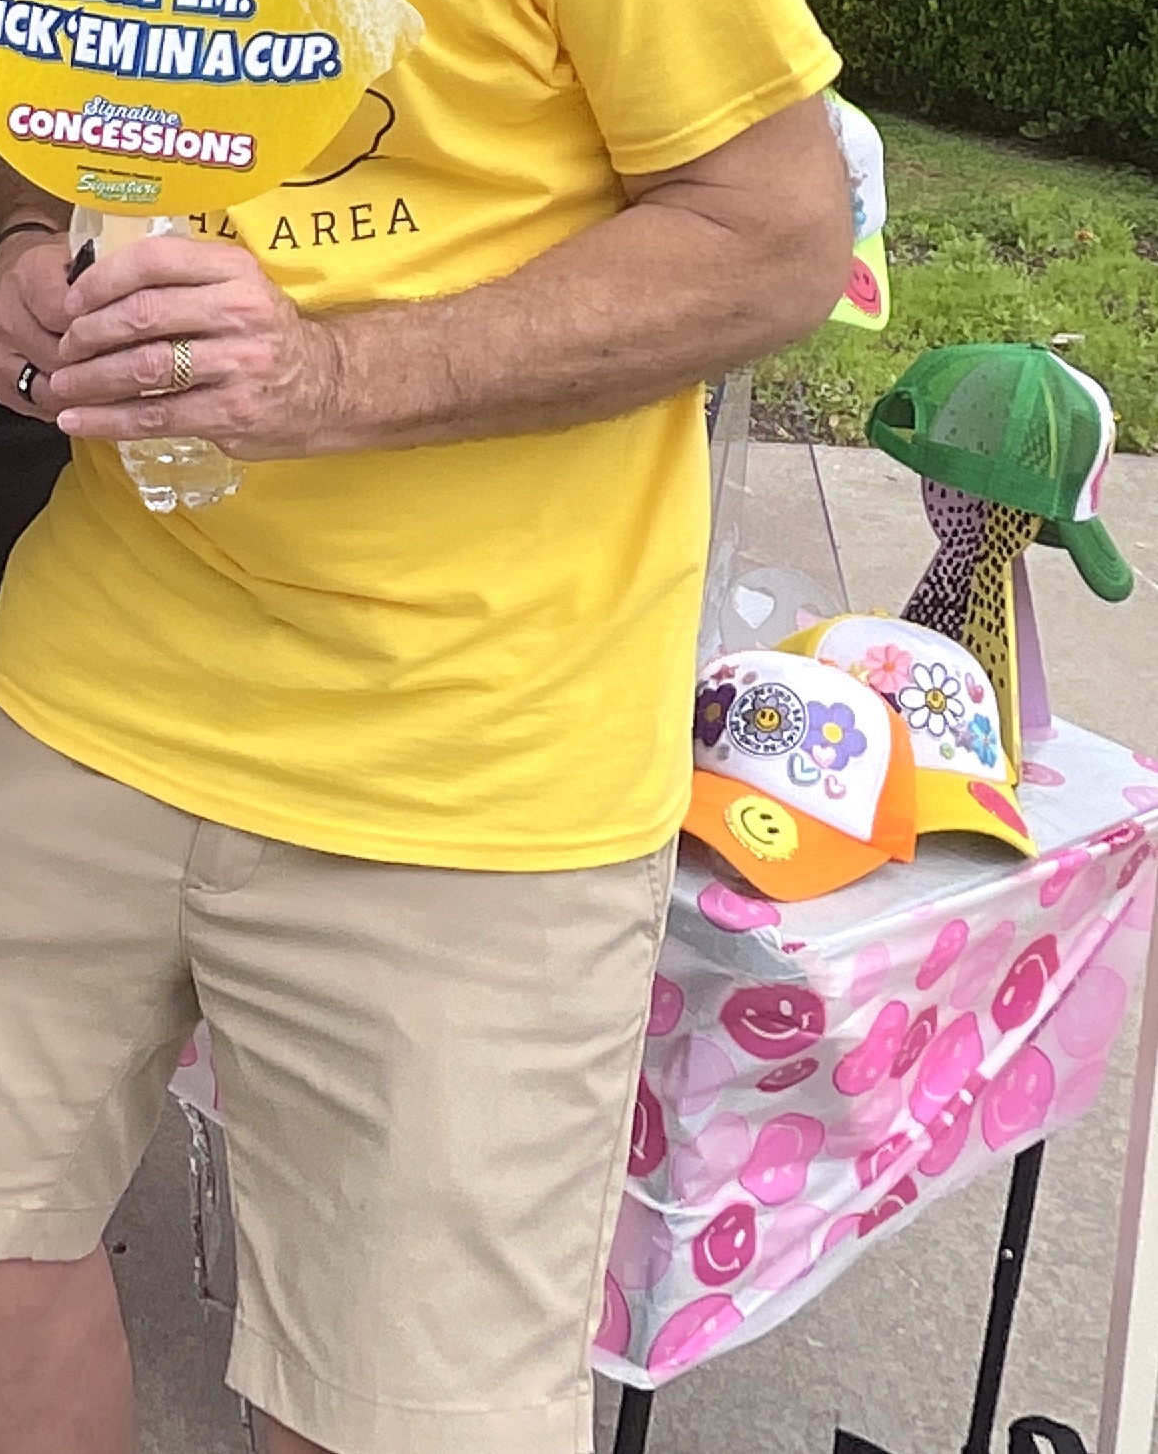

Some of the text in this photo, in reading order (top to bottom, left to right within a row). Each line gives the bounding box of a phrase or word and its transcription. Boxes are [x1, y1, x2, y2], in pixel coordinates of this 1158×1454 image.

[141, 24, 200, 80] IN
[200, 29, 241, 81] A
[242, 32, 341, 82] CUP.
[8, 104, 255, 171] CONCESSIONS
[83, 95, 181, 127] Signature
[269, 197, 419, 249] AREA
